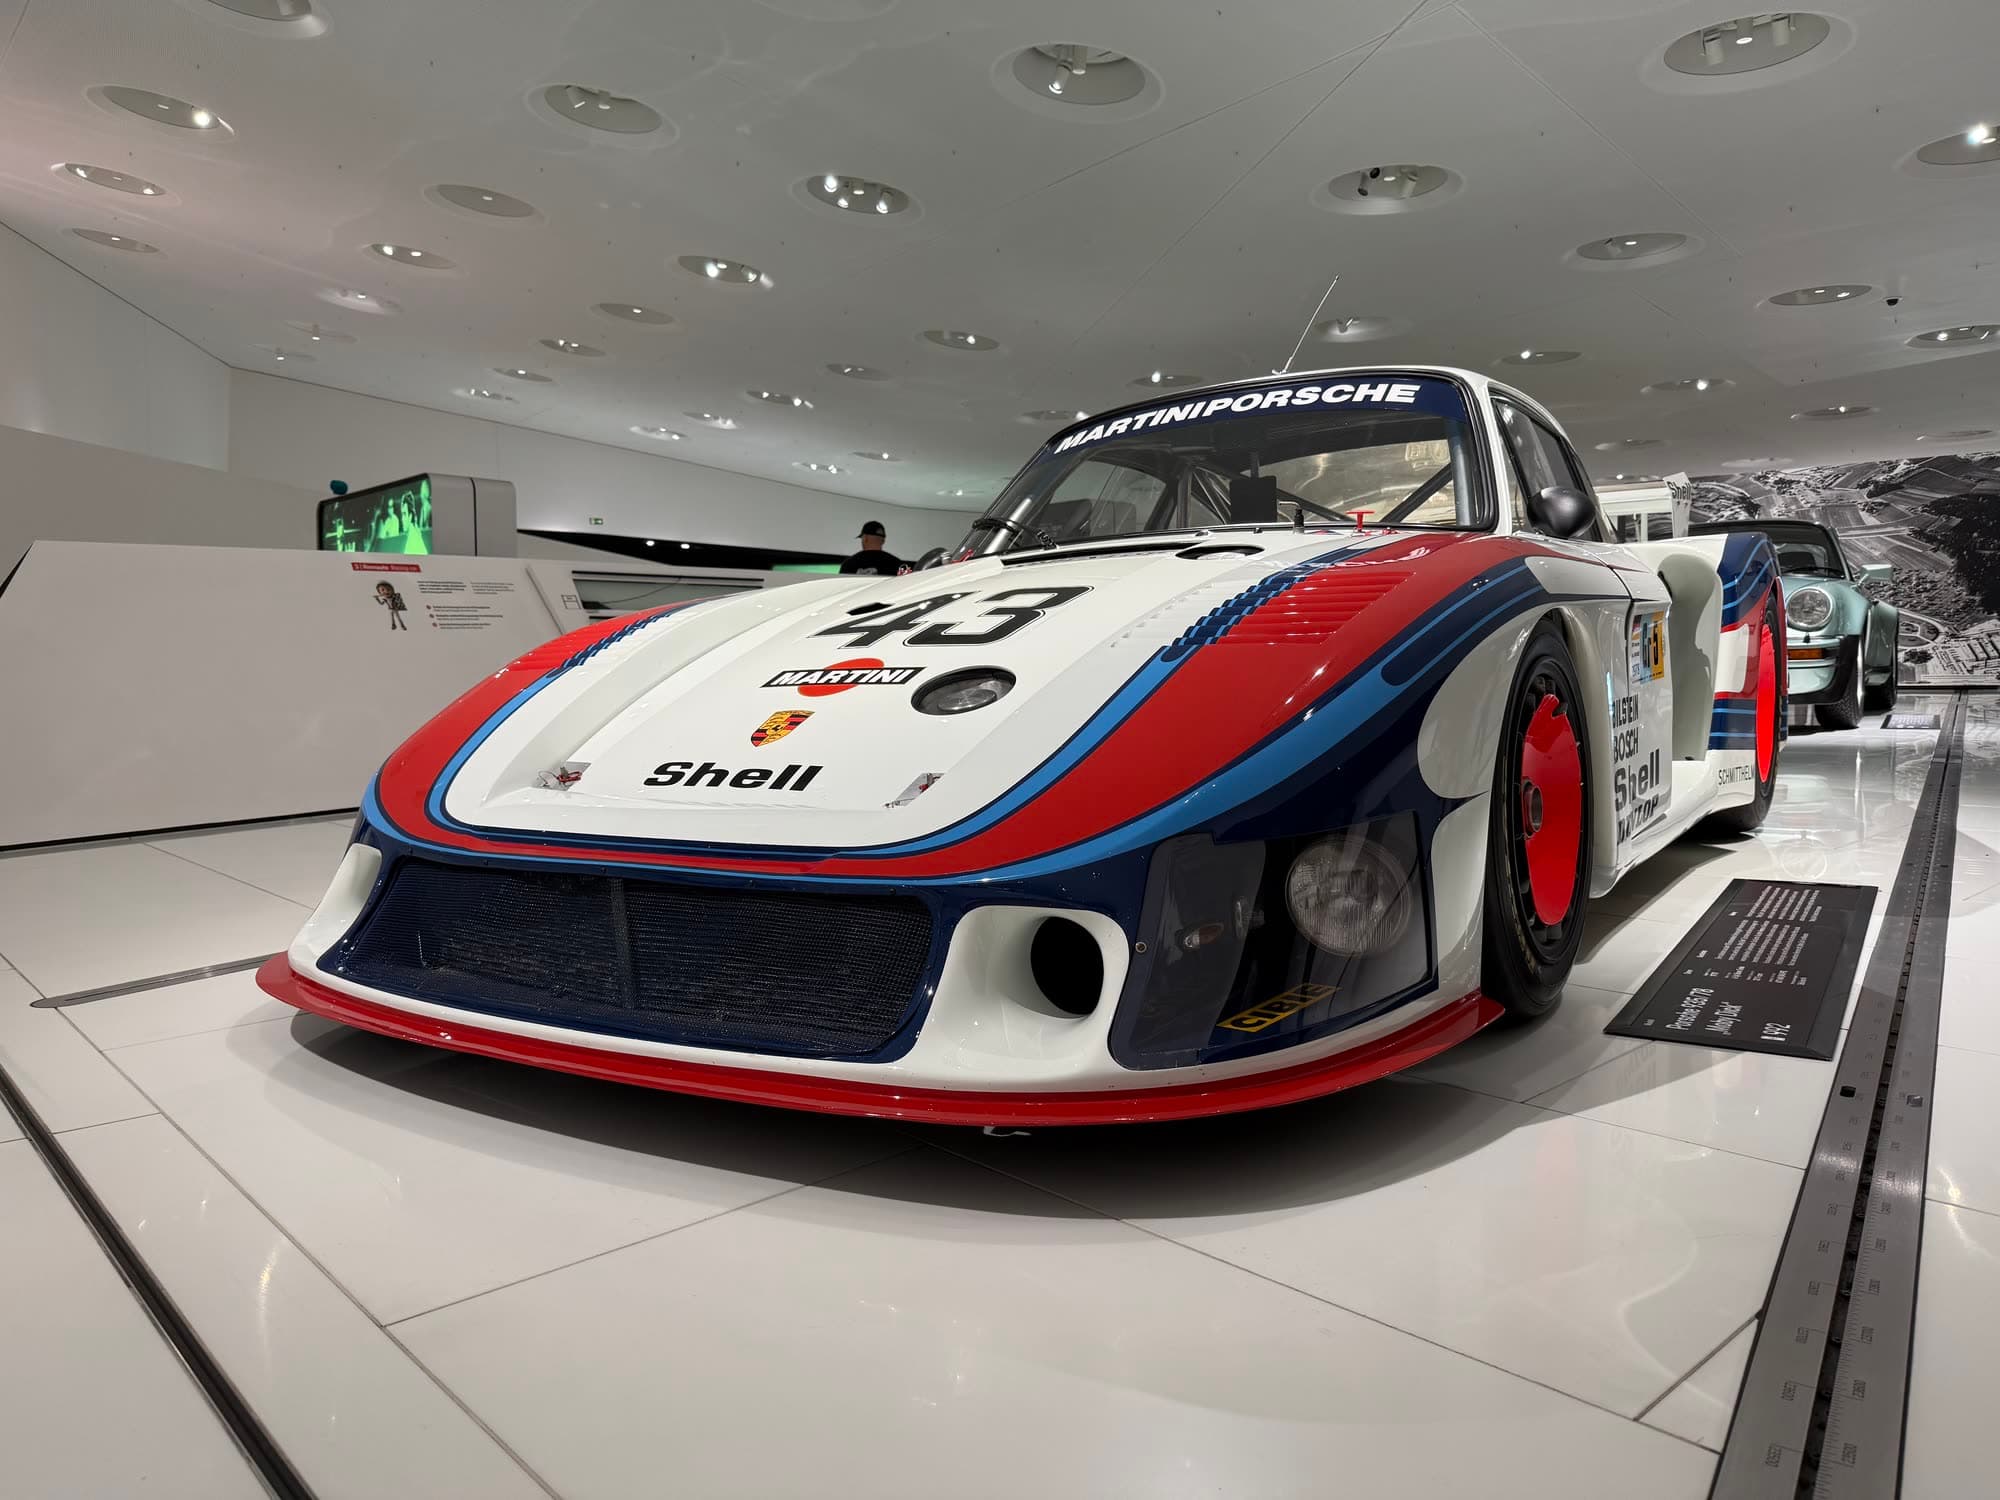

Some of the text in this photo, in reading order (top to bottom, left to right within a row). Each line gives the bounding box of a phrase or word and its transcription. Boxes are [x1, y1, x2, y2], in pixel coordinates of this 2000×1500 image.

[1667, 481, 1692, 500] Shell
[806, 585, 1094, 649] 43
[773, 668, 913, 686] MARTINI
[1613, 727, 1639, 764] BOSCH
[643, 762, 824, 791] Shell
[1614, 748, 1660, 812] Shell
[1680, 988, 1714, 1009] 935/78
[1665, 1008, 1700, 1030] Porsche
